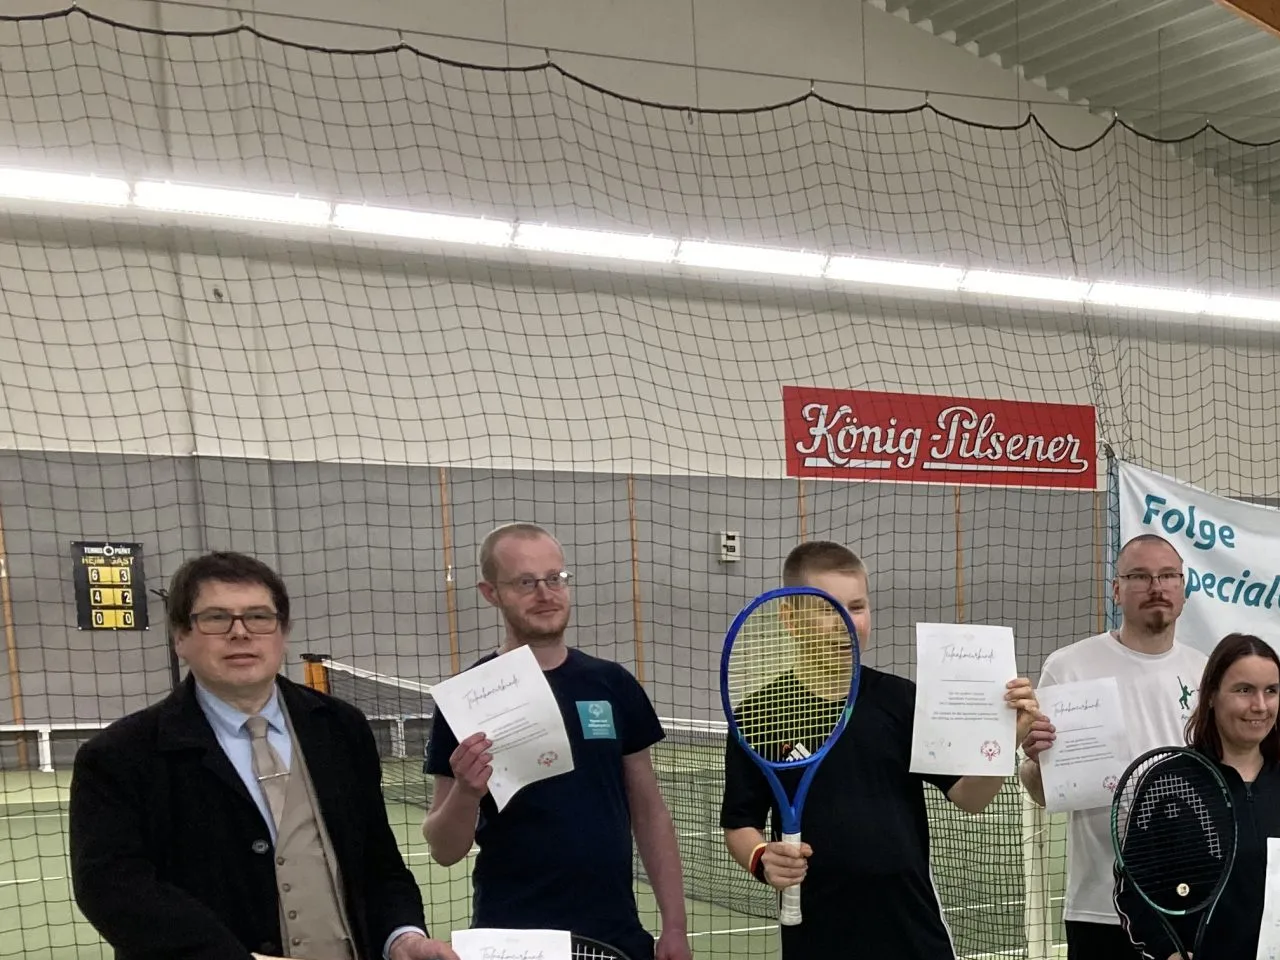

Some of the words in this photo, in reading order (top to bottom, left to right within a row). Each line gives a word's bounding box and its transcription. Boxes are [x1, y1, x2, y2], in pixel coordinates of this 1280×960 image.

[1142, 493, 1236, 550] Folge
[110, 556, 134, 566] GAST
[91, 569, 98, 581] 6
[121, 570, 128, 581] 3
[94, 591, 101, 602] 4
[124, 592, 131, 603] 2
[96, 613, 103, 624] 0
[125, 613, 132, 624] 0
